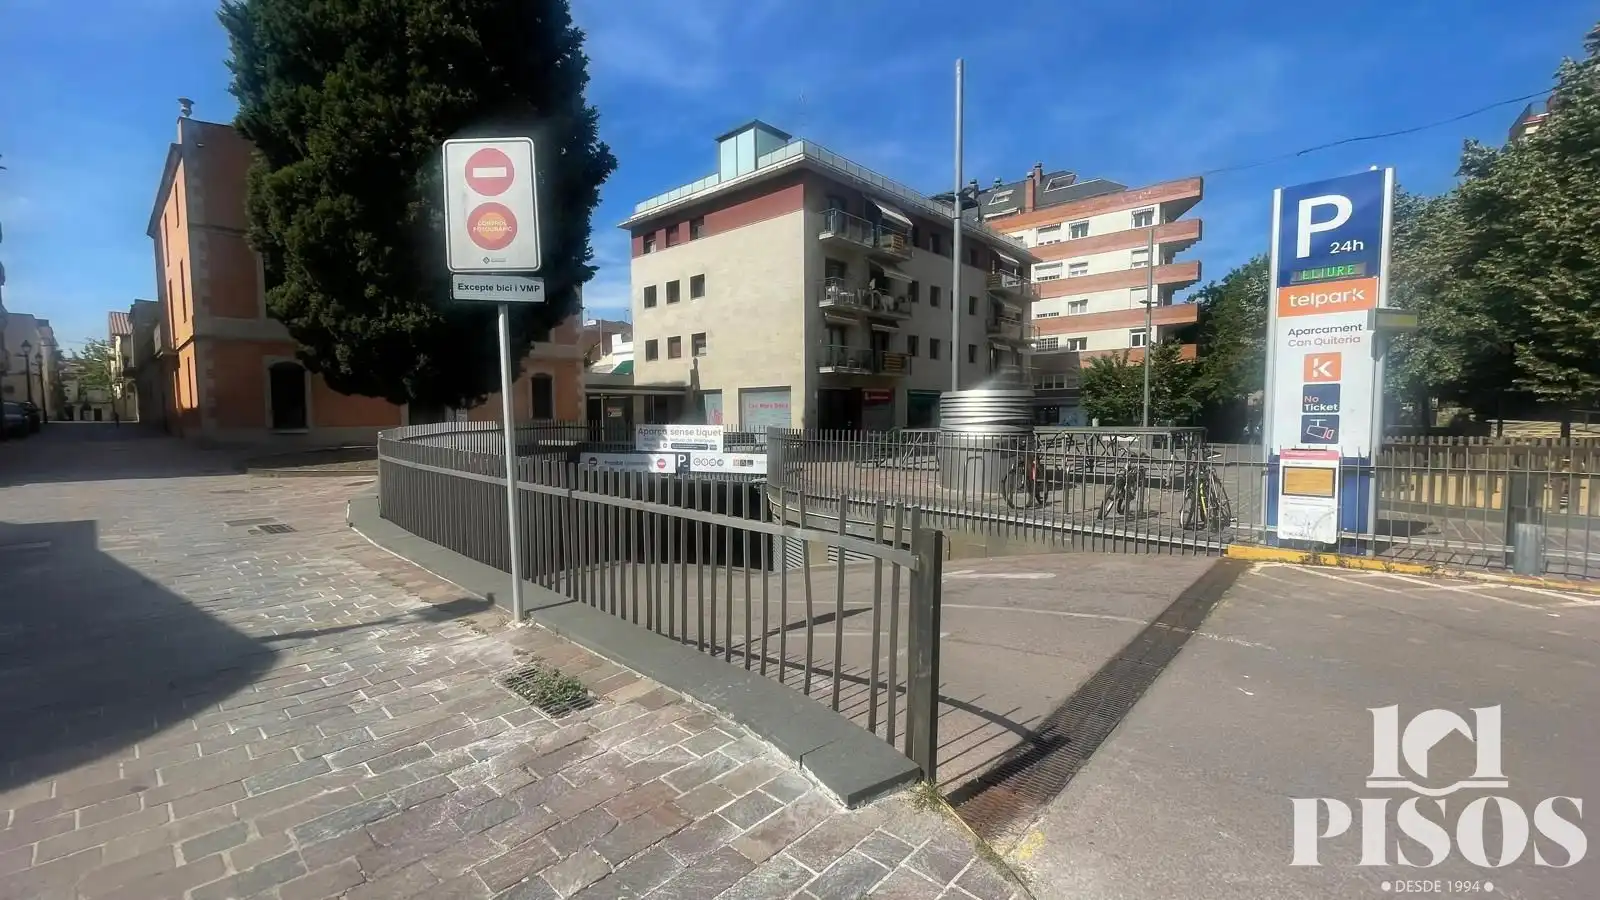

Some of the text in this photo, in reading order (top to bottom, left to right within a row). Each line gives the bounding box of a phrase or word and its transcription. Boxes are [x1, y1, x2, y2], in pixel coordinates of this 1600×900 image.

[1297, 194, 1364, 259] P 24h
[458, 282, 494, 292] Excepte
[496, 283, 513, 292] bici
[520, 285, 541, 293] VMP
[1288, 288, 1366, 308] telpark
[1288, 323, 1363, 337] Aparcament
[1288, 335, 1361, 347] Can Quiteria
[1304, 395, 1319, 403] No
[1304, 403, 1338, 412] Ticket
[638, 427, 722, 438] Aparca sense tiquet
[677, 454, 687, 467] P
